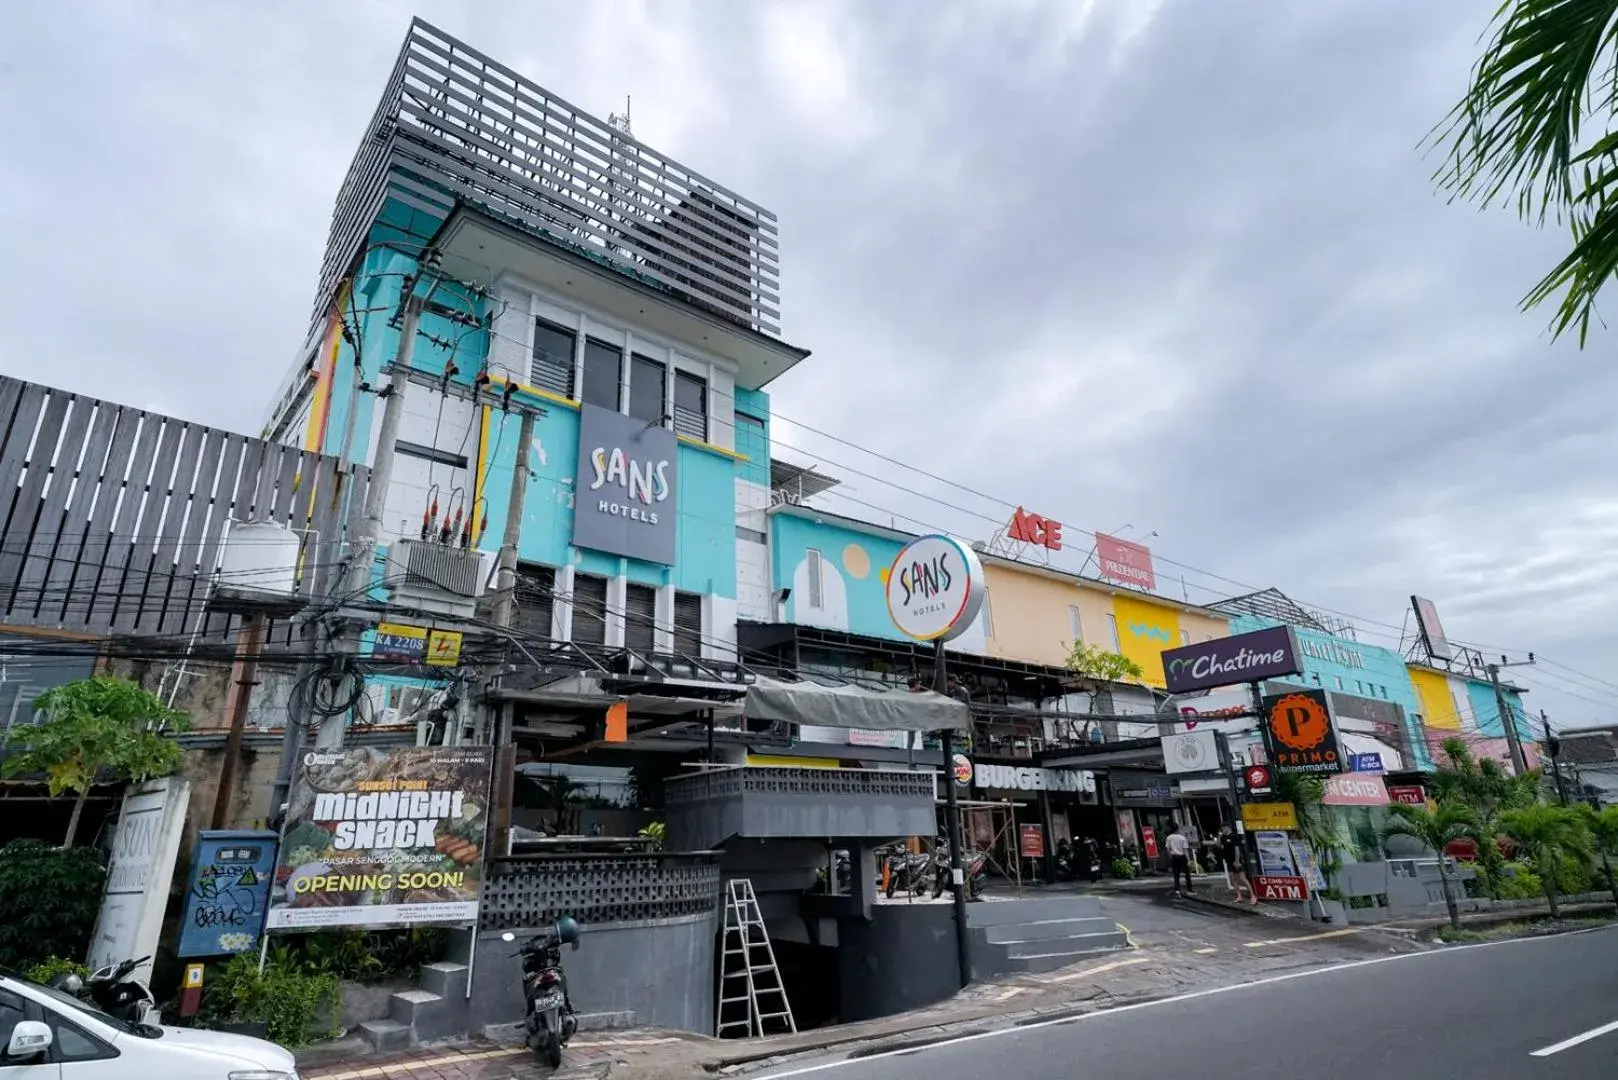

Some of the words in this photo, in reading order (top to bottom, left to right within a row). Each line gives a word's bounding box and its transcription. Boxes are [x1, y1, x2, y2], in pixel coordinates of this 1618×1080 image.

[590, 447, 669, 504] SANS
[599, 499, 659, 525] HOTELS
[1007, 504, 1062, 551] ACE
[900, 552, 952, 607] SANS
[913, 602, 946, 617] HOTELS
[376, 633, 391, 646] KA
[395, 637, 424, 650] 2208
[1191, 647, 1285, 680] Chatime
[1278, 750, 1337, 765] PRIMO
[974, 764, 1053, 791] BURGER
[1053, 769, 1096, 792] KING
[1340, 780, 1381, 798] CENTER
[1398, 793, 1419, 803] ATM
[1272, 810, 1289, 818] ATM
[355, 855, 398, 865] SENGGOL
[293, 873, 392, 894] OPENING
[397, 871, 464, 890] SOON!
[1265, 885, 1301, 899] ATM
